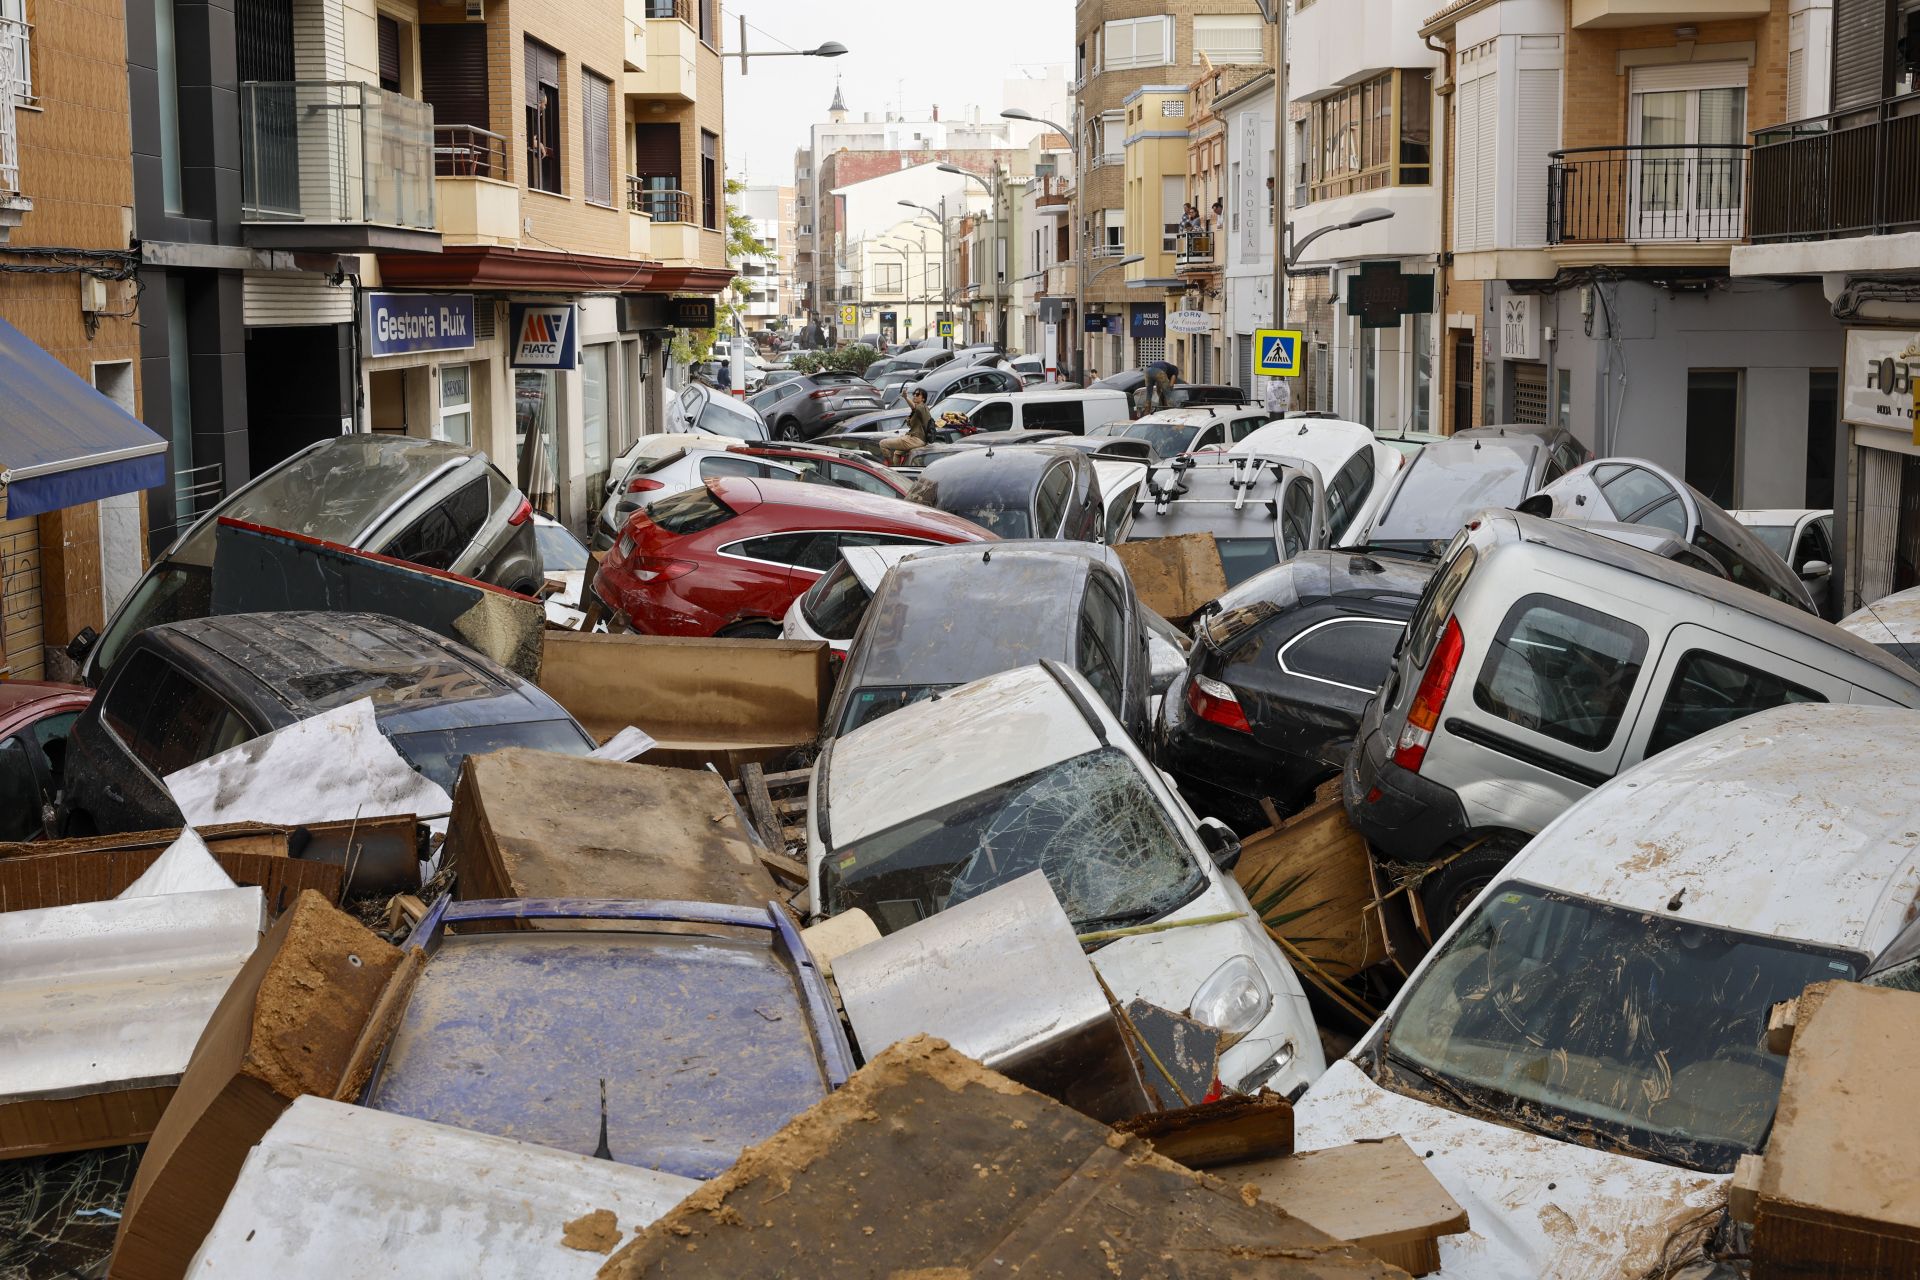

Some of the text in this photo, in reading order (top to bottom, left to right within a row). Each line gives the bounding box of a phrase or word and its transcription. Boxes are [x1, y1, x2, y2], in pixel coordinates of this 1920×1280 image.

[1246, 118, 1255, 177] EMILIO
[377, 306, 467, 342] Gestoria Ruix
[521, 343, 556, 354] FIATC
[1876, 405, 1892, 415] MODA
[1896, 407, 1902, 417] Y
